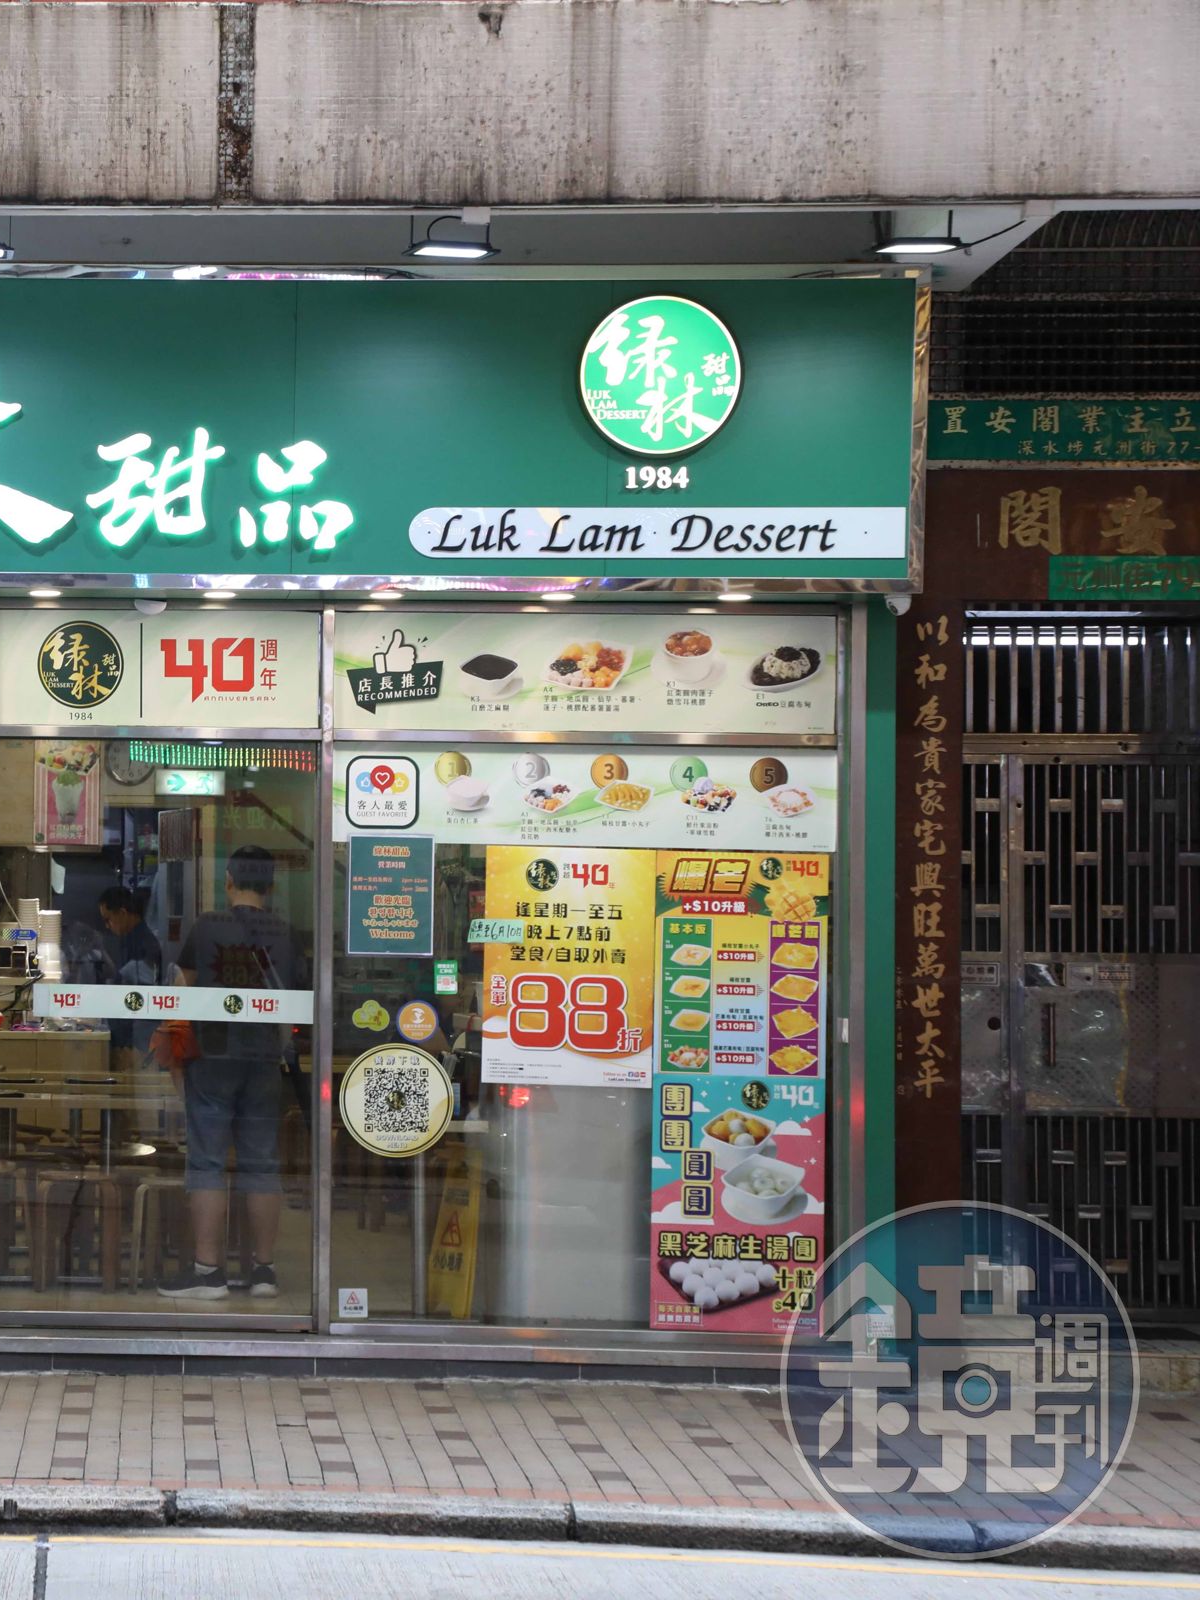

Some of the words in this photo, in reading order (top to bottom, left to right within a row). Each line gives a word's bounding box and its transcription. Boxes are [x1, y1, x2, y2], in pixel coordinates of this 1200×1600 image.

[587, 389, 612, 400] LUK
[592, 400, 618, 410] LAM
[596, 409, 648, 421] DESSERT
[625, 466, 690, 489] 1984
[431, 508, 521, 553] Luk
[539, 512, 644, 553] Lam
[670, 513, 838, 553] Dessert
[160, 637, 255, 703] 40
[259, 638, 278, 691] 週年
[357, 670, 438, 693] 店長推介
[357, 686, 438, 702] RECOMMENDED
[68, 712, 93, 721] 1984
[525, 762, 537, 779] 2
[603, 763, 615, 780] 3
[682, 766, 694, 783] 4
[763, 767, 774, 785] 5
[357, 800, 408, 811] 客人最愛
[571, 863, 609, 888] 40
[791, 860, 820, 878] 40
[516, 902, 624, 920] 逢星期一至五
[369, 929, 415, 940] Welcome
[526, 925, 611, 942] 晚上7點前
[510, 946, 626, 964] 堂食/自取外賣
[53, 993, 76, 1009] 40
[153, 995, 175, 1011] 40
[252, 998, 274, 1013] 40
[507, 973, 628, 1052] 88
[616, 1028, 642, 1053] 折
[781, 1084, 814, 1107] 40
[658, 1231, 819, 1263] 黑芝麻生湯圓
